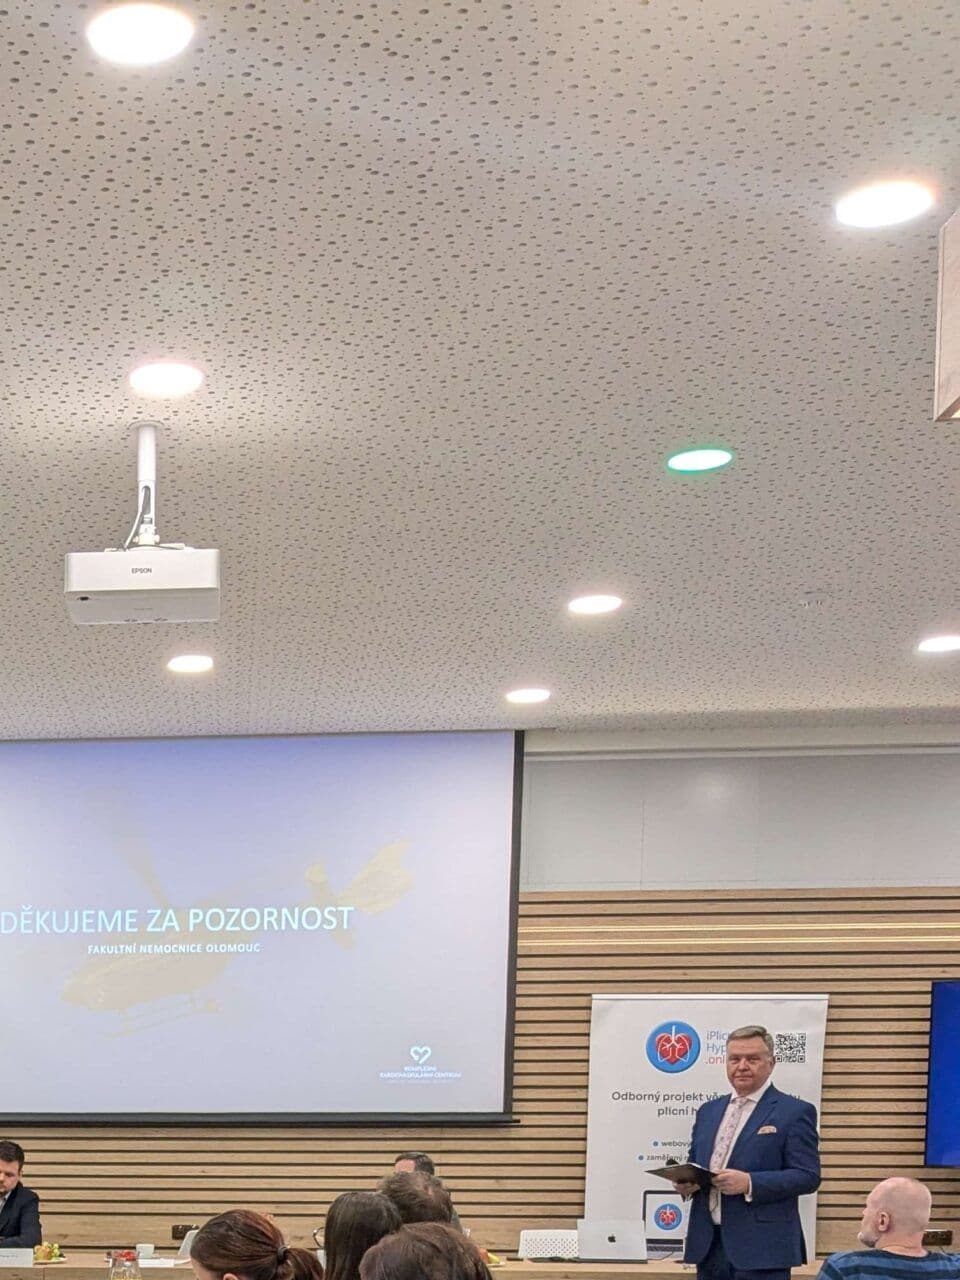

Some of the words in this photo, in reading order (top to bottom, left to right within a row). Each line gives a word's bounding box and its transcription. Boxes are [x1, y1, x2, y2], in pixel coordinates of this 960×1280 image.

[0, 904, 138, 934] DĚKUJEME
[146, 908, 180, 932] ZA
[189, 906, 355, 932] POZORNOST
[87, 943, 136, 954] FAKULTNÍ
[140, 943, 202, 953] NEMOCNICE
[206, 943, 261, 953] OLOMOUC
[611, 1091, 660, 1102] Odborný
[662, 1092, 703, 1102] projekt
[657, 1106, 689, 1117] plicní
